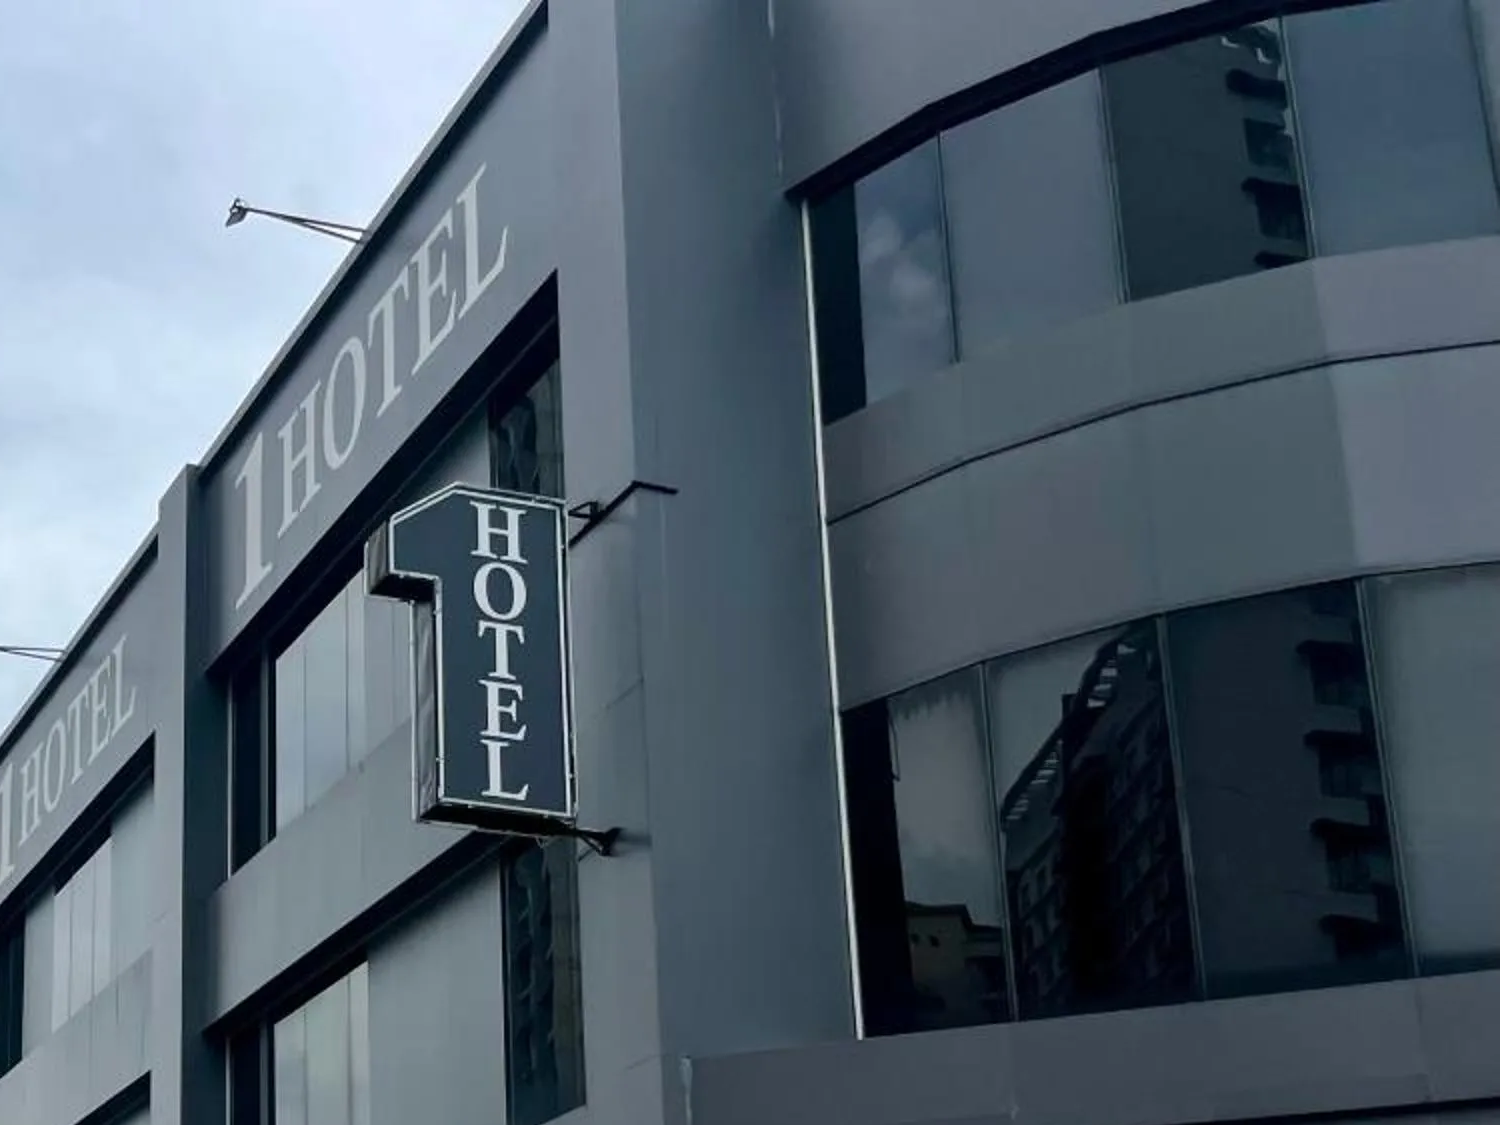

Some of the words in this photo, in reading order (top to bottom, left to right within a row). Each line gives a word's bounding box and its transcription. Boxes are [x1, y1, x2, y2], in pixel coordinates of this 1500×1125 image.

[234, 431, 272, 609] 1
[277, 162, 508, 540] HOTEL
[20, 634, 138, 846] HOTEL
[470, 500, 529, 801] HOTEL
